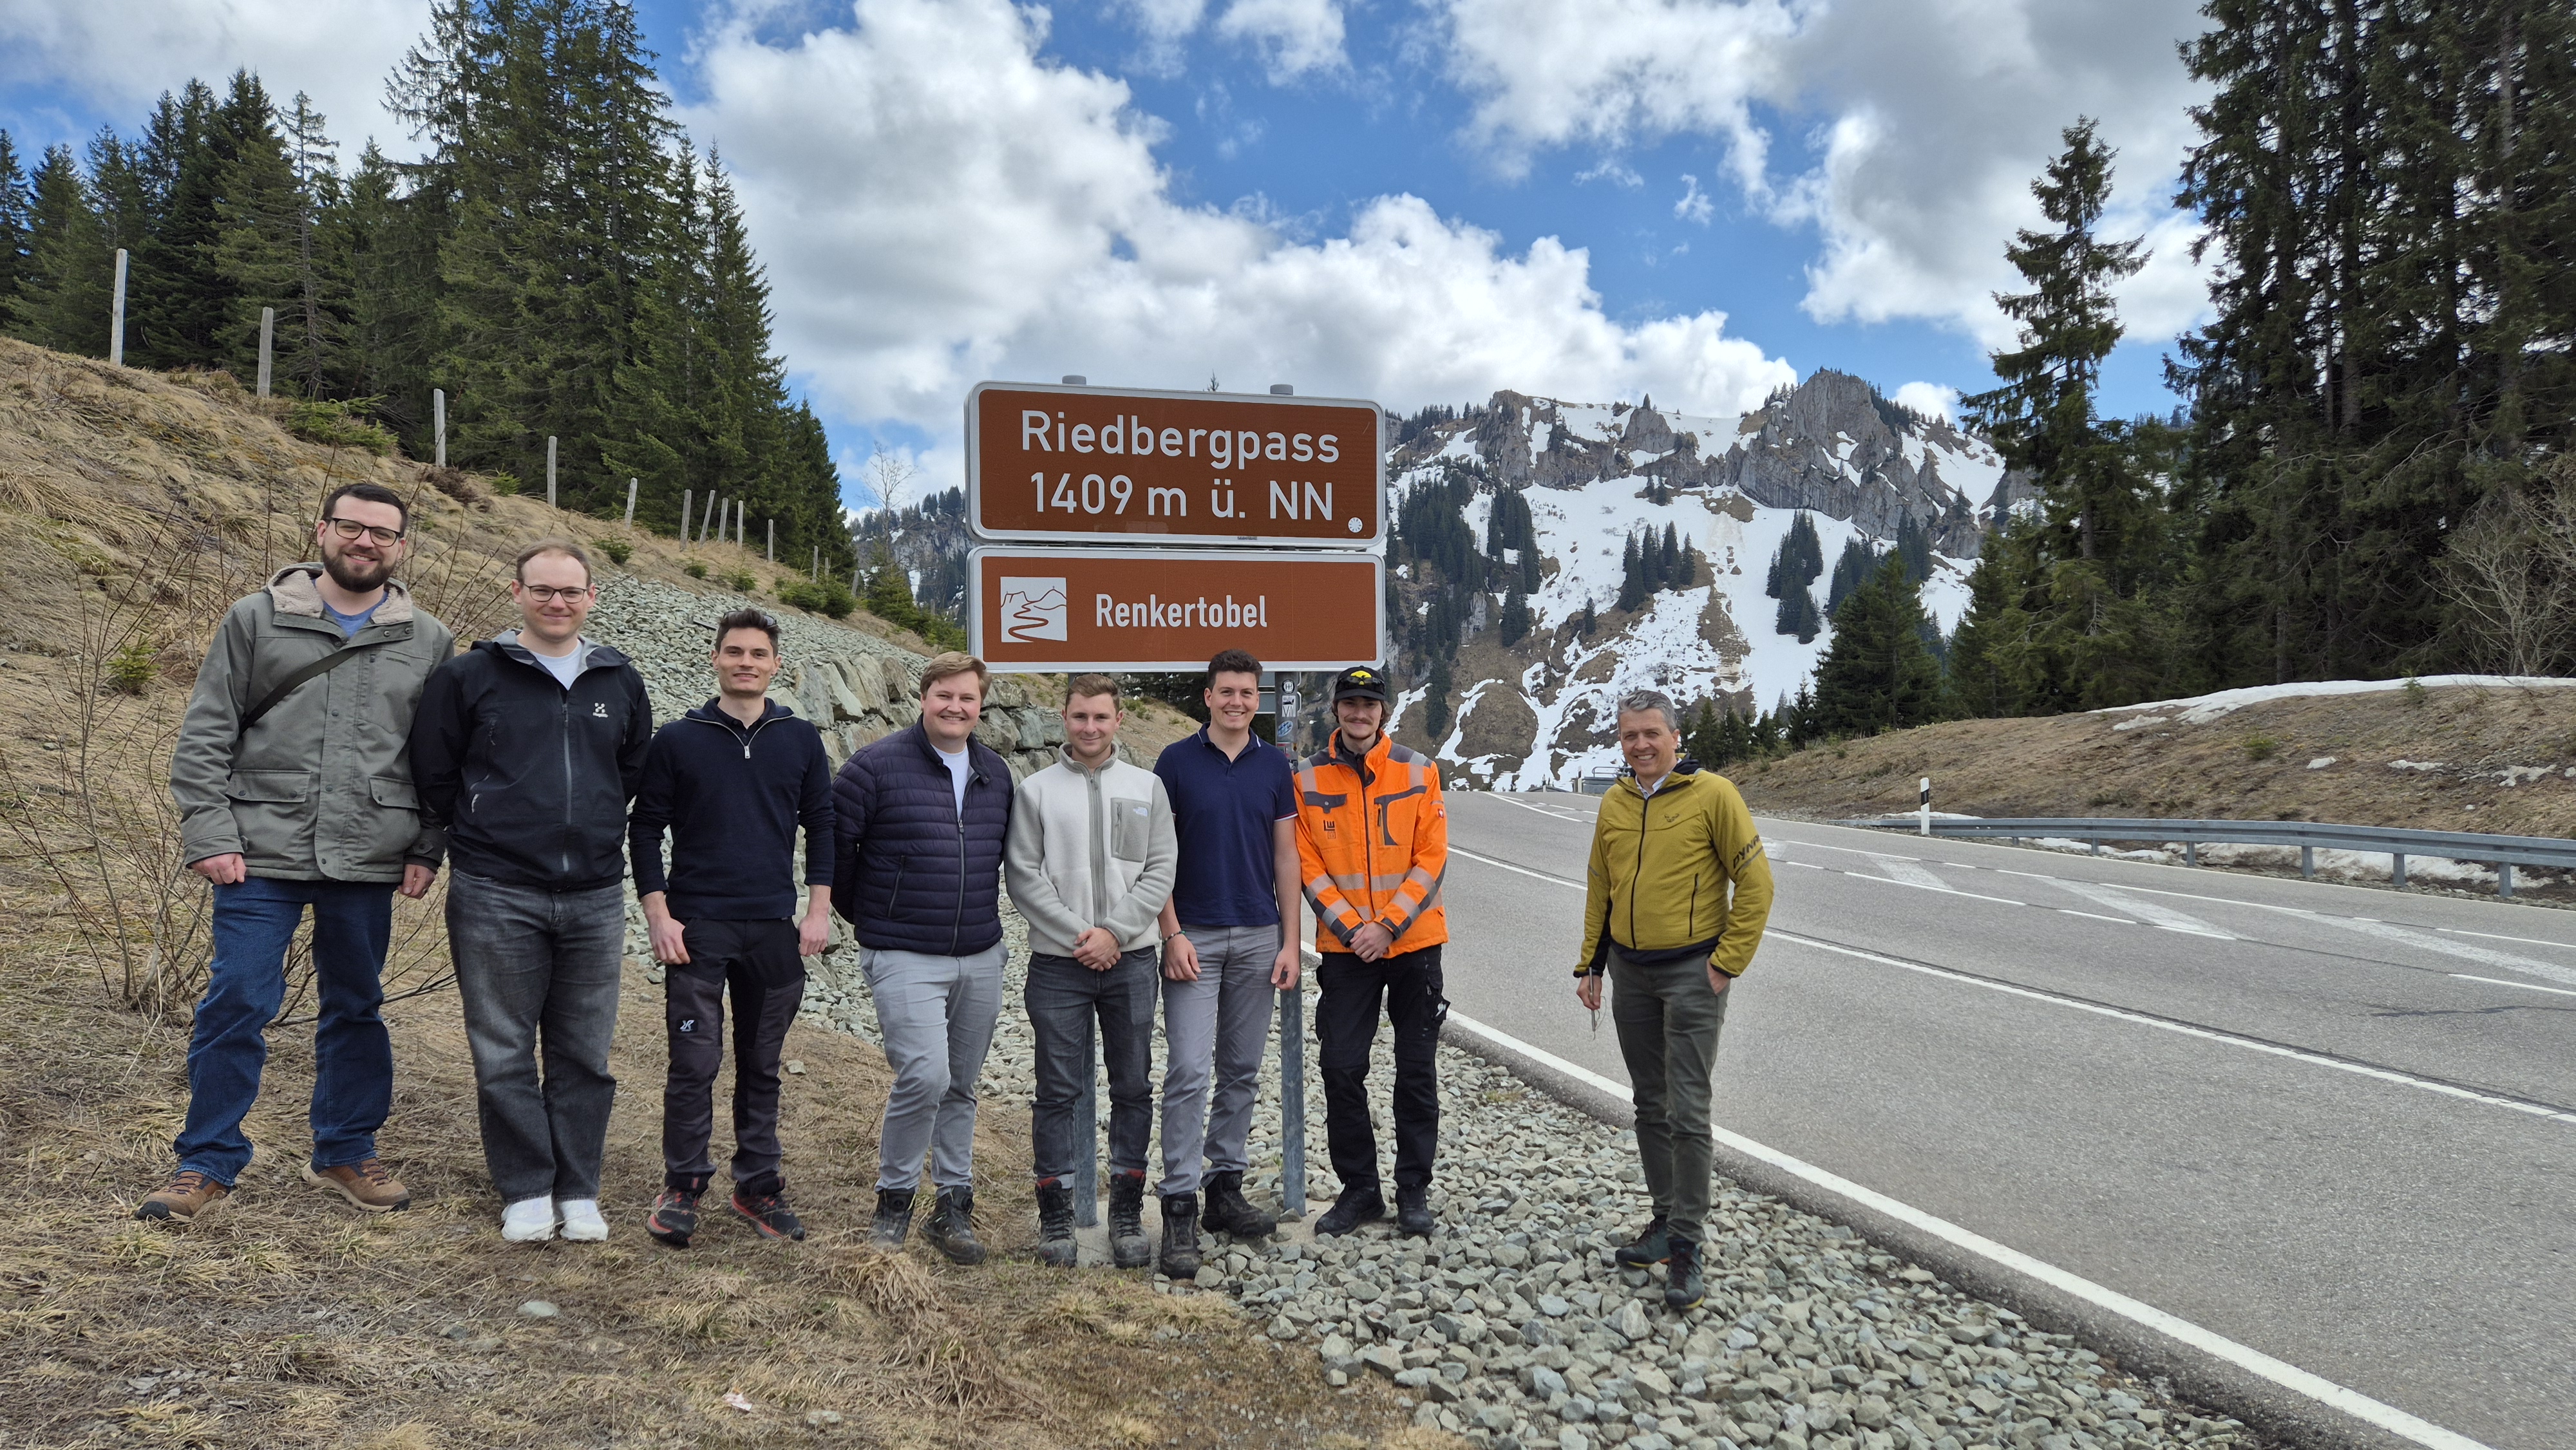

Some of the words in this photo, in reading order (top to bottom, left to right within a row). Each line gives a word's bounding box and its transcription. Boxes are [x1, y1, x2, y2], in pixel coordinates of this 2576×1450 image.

[1022, 410, 1340, 470] Riedbergpass
[1031, 472, 1133, 514] 1409
[1148, 487, 1187, 516] m
[1211, 478, 1245, 518] ü.
[1269, 480, 1332, 521] NN
[1096, 594, 1267, 628] Renkertobel
